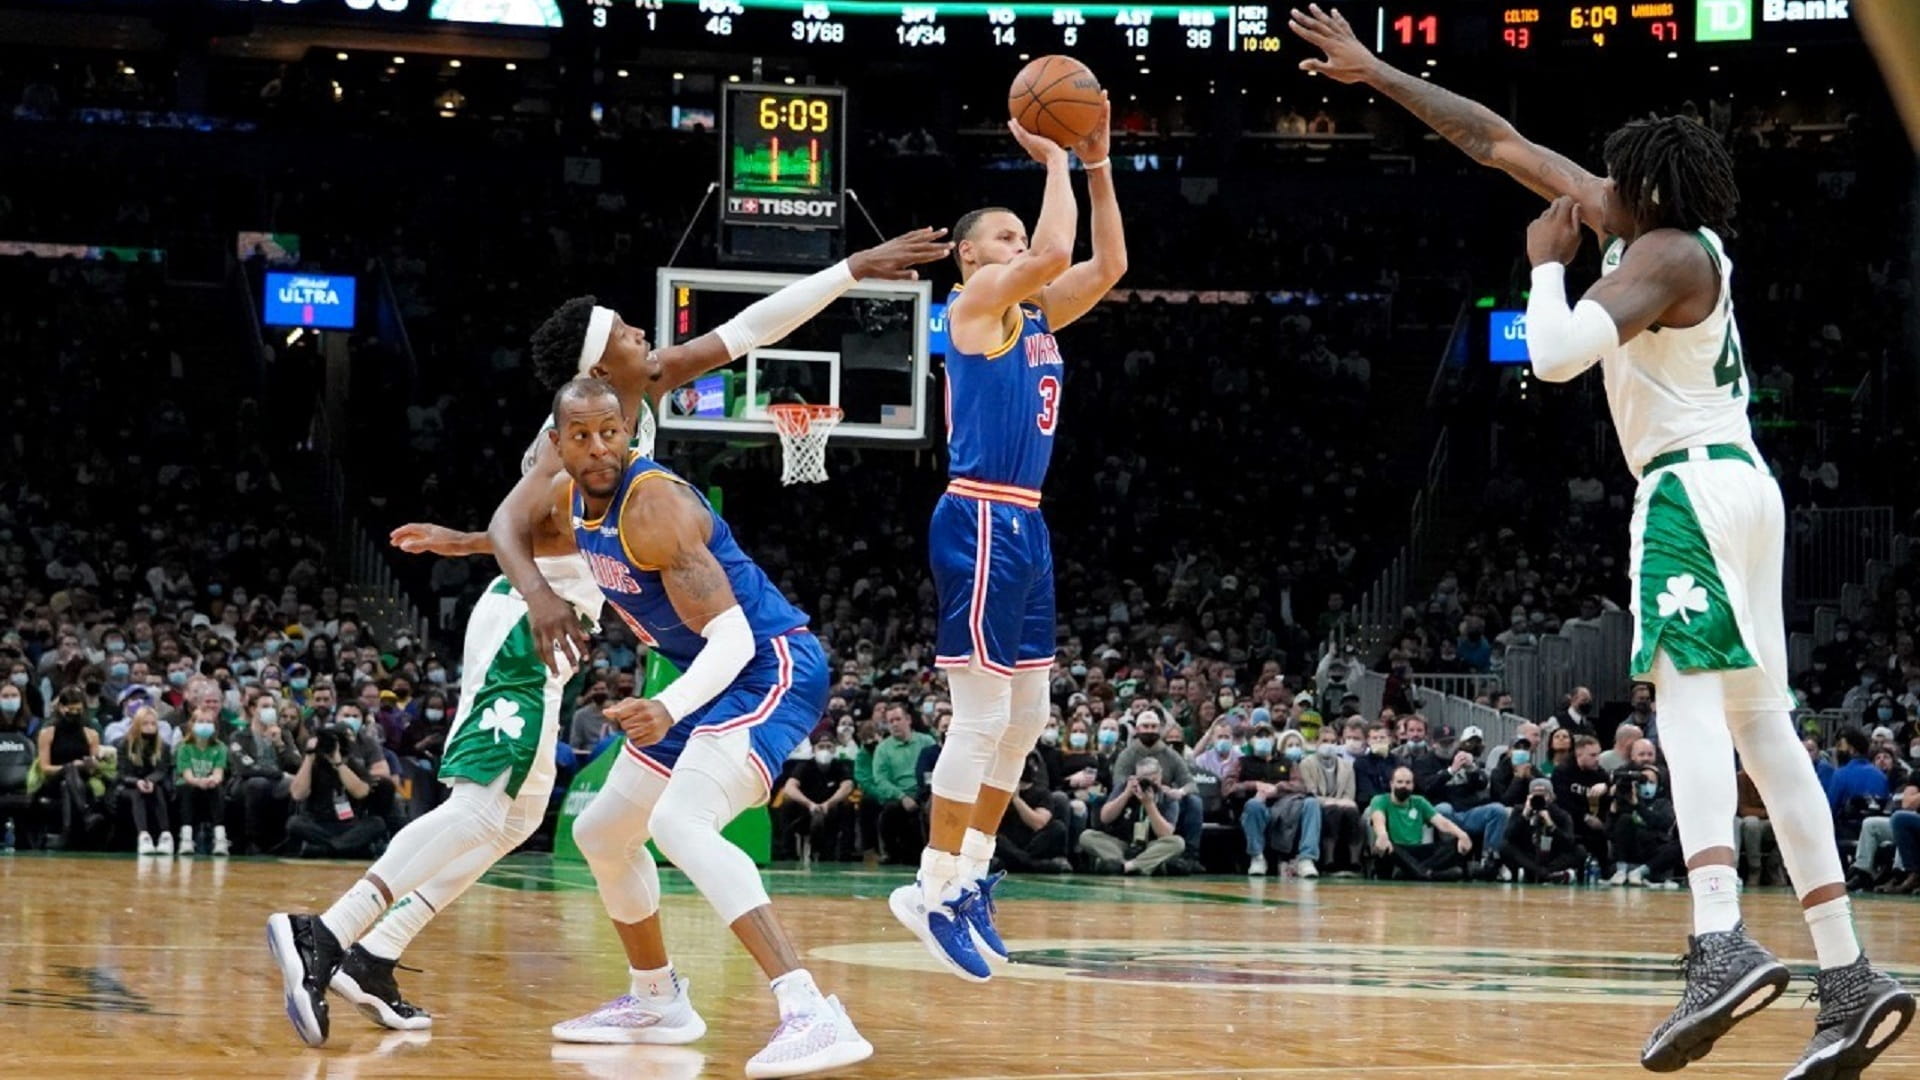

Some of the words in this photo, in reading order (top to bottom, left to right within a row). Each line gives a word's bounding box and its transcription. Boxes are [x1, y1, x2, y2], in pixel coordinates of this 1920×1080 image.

[593, 8, 607, 27] 3
[647, 12, 656, 31] 1
[1053, 8, 1085, 25] STL
[1115, 9, 1152, 26] AST
[1238, 6, 1267, 20] MEM
[1505, 9, 1539, 23] CELTICS
[1571, 6, 1617, 29] 6:09
[1704, 1, 1746, 32] TD
[1763, 0, 1848, 21] Bank
[705, 16, 732, 35] 46
[792, 21, 844, 43] 31/68
[1238, 21, 1266, 35] SAC
[1394, 15, 1437, 45] 11
[1651, 22, 1677, 41] 97
[896, 25, 946, 46] 14/34
[992, 27, 1016, 46] 14
[1064, 27, 1077, 46] 5
[1125, 28, 1149, 47] 18
[1187, 29, 1211, 48] 38
[1243, 37, 1280, 52] 10:00
[1504, 28, 1529, 48] 93
[1592, 33, 1604, 47] 4
[760, 98, 828, 132] 6:09
[758, 200, 837, 217] TISSOT
[279, 288, 340, 305] ULTRA
[1504, 325, 1527, 340] UL
[1024, 332, 1064, 367] WAR
[1713, 318, 1743, 399] 4
